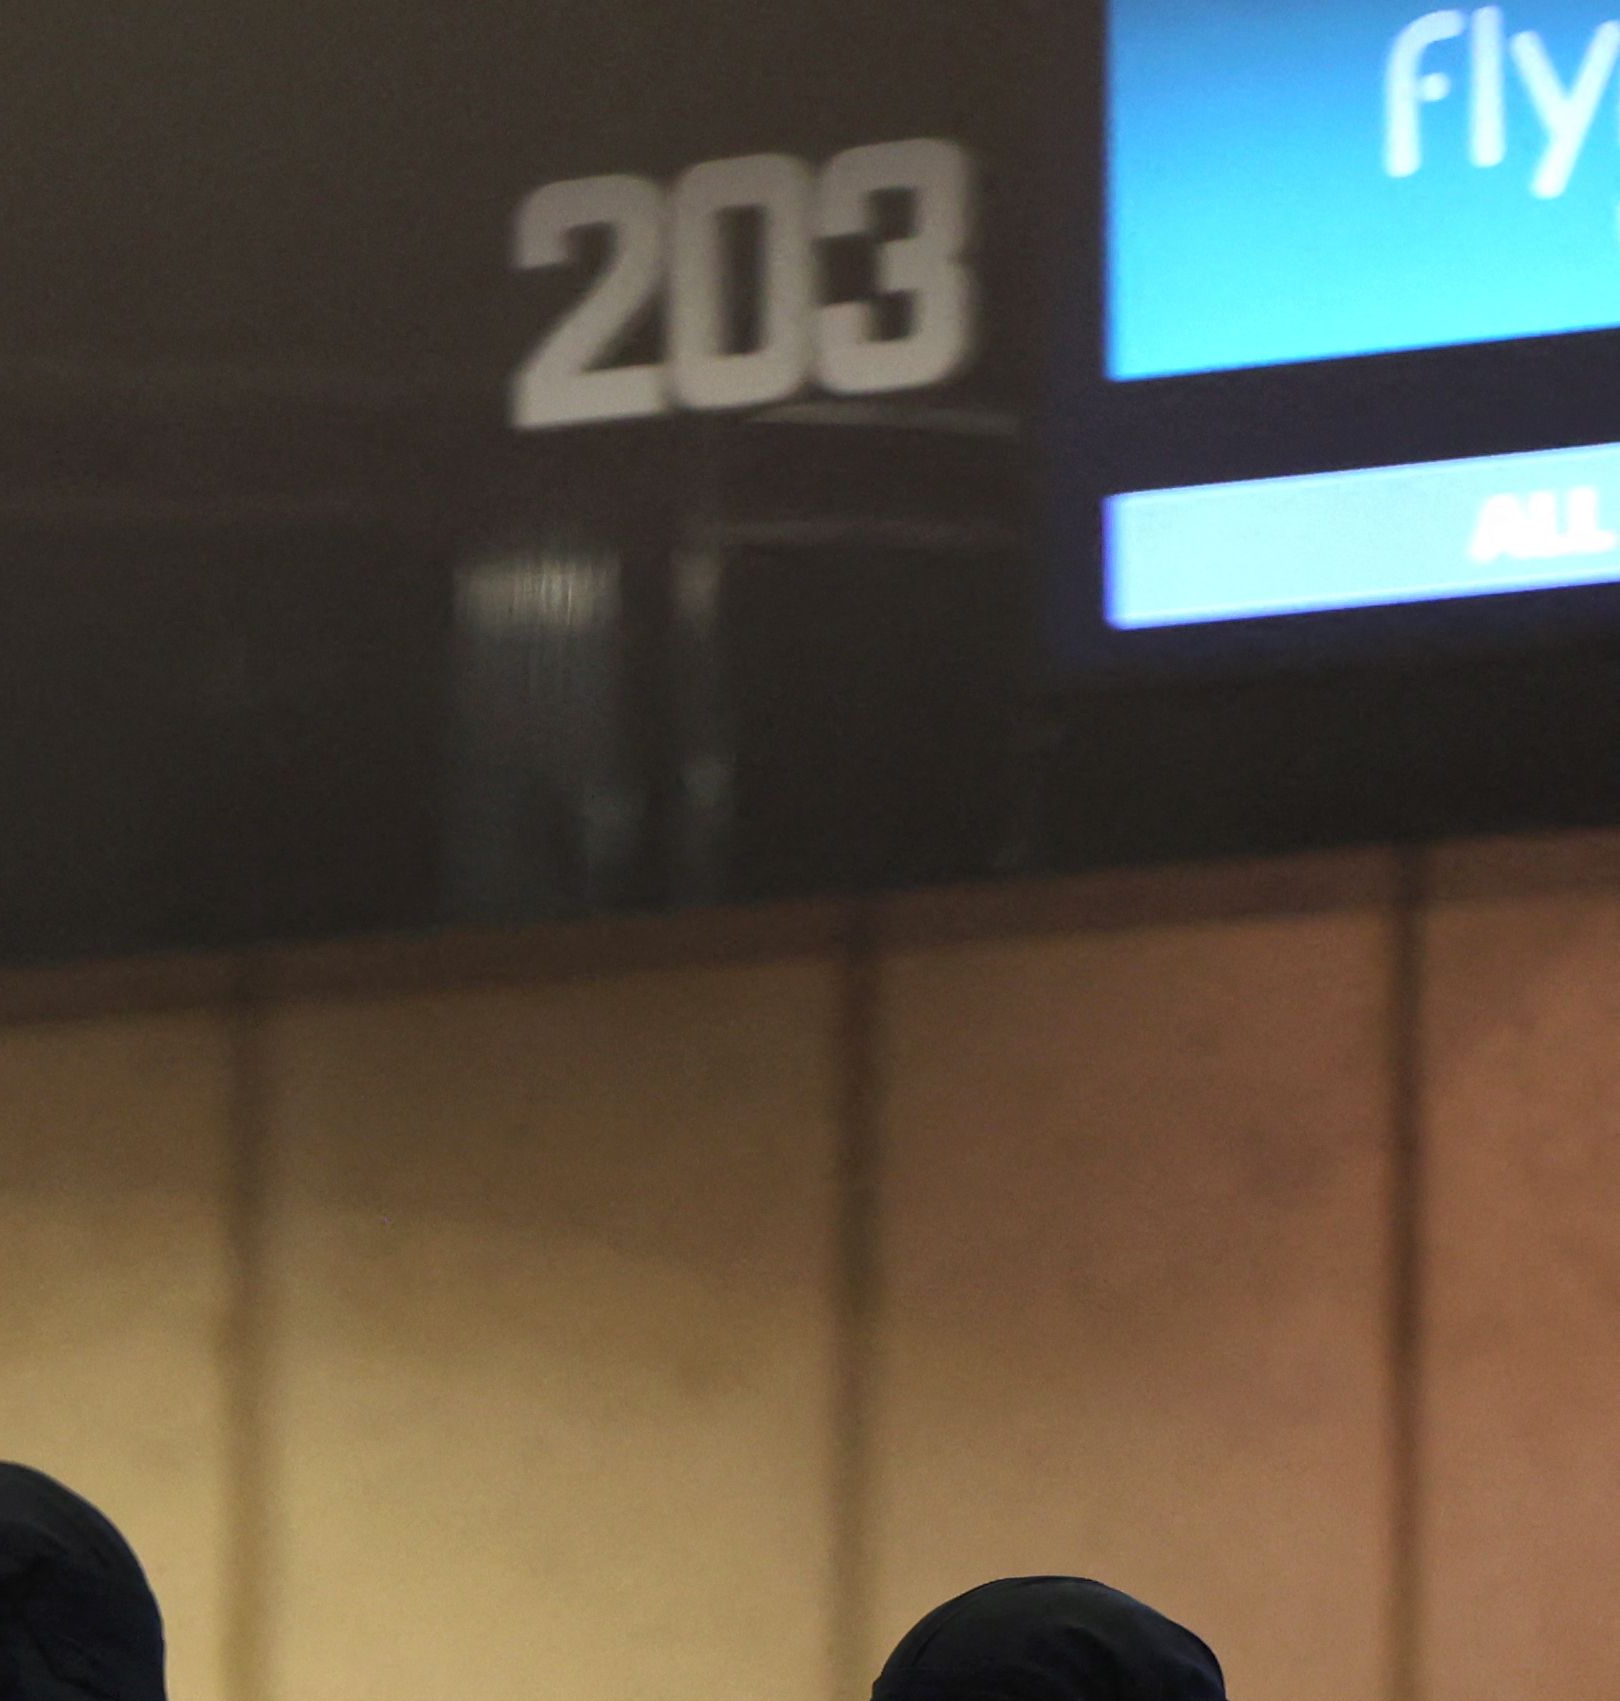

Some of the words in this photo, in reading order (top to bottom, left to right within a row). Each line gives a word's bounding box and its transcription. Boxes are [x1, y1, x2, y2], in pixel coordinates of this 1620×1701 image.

[1384, 4, 1620, 198] fly
[511, 138, 979, 430] 203
[1466, 489, 1616, 562] ALL
